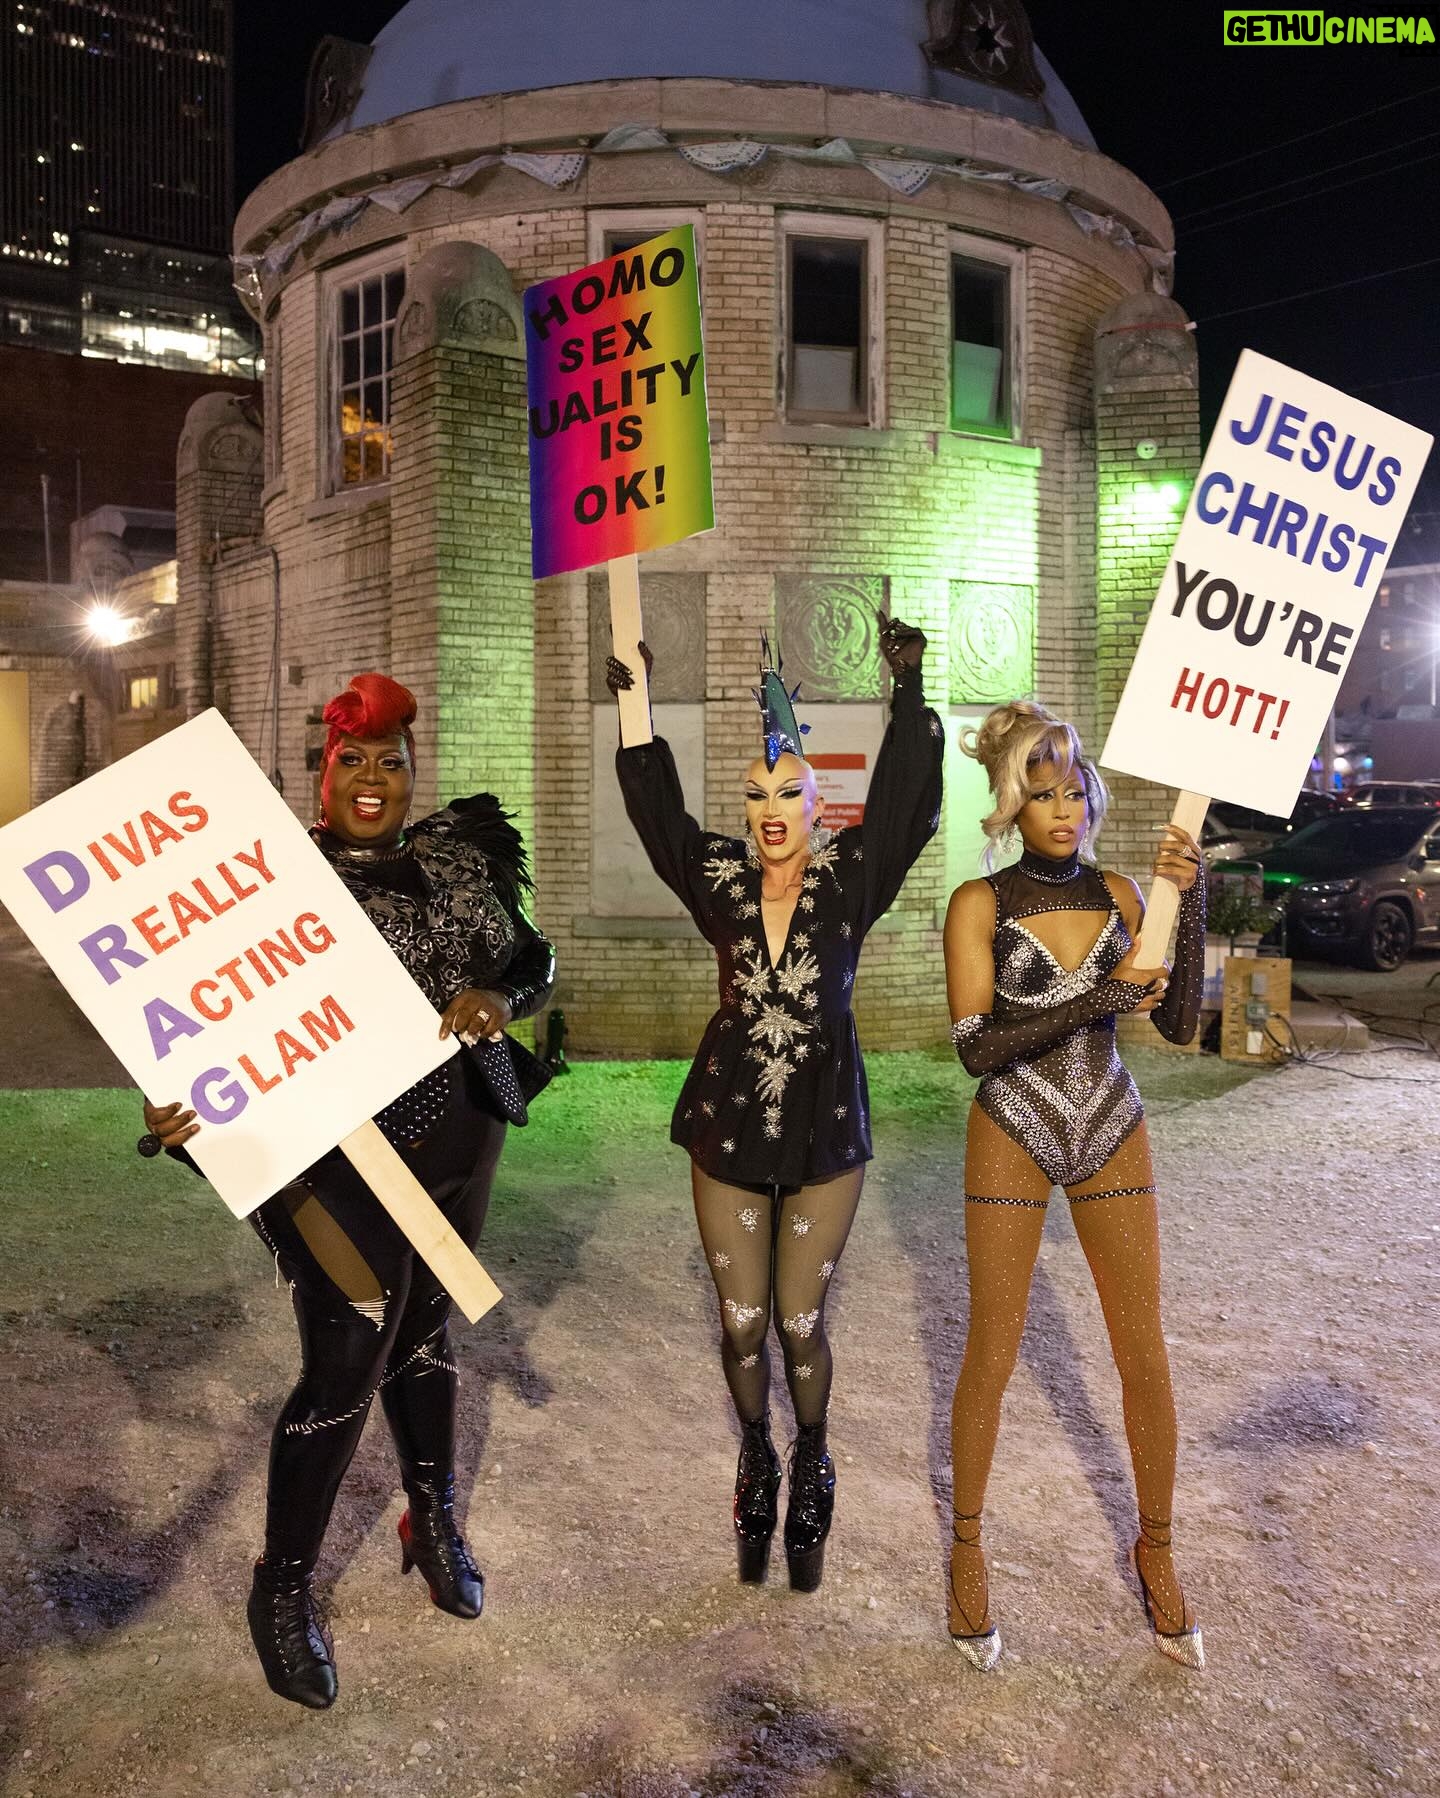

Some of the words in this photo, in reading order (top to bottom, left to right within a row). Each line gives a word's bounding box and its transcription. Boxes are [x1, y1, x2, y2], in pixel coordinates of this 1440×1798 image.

[530, 247, 685, 341] HOMO
[558, 311, 653, 373] SEX
[530, 352, 701, 440] UALITY
[600, 415, 643, 461] IS
[1230, 393, 1402, 506] JESUS
[573, 464, 665, 526] OK!
[1196, 471, 1388, 588] CHRIST
[1171, 560, 1355, 676] YOU'RE
[1170, 667, 1291, 741] HOTT!
[22, 790, 210, 914] DIVAS
[78, 838, 276, 986] REALLY
[143, 911, 338, 1061] ACTING
[190, 994, 356, 1125] GLAM
